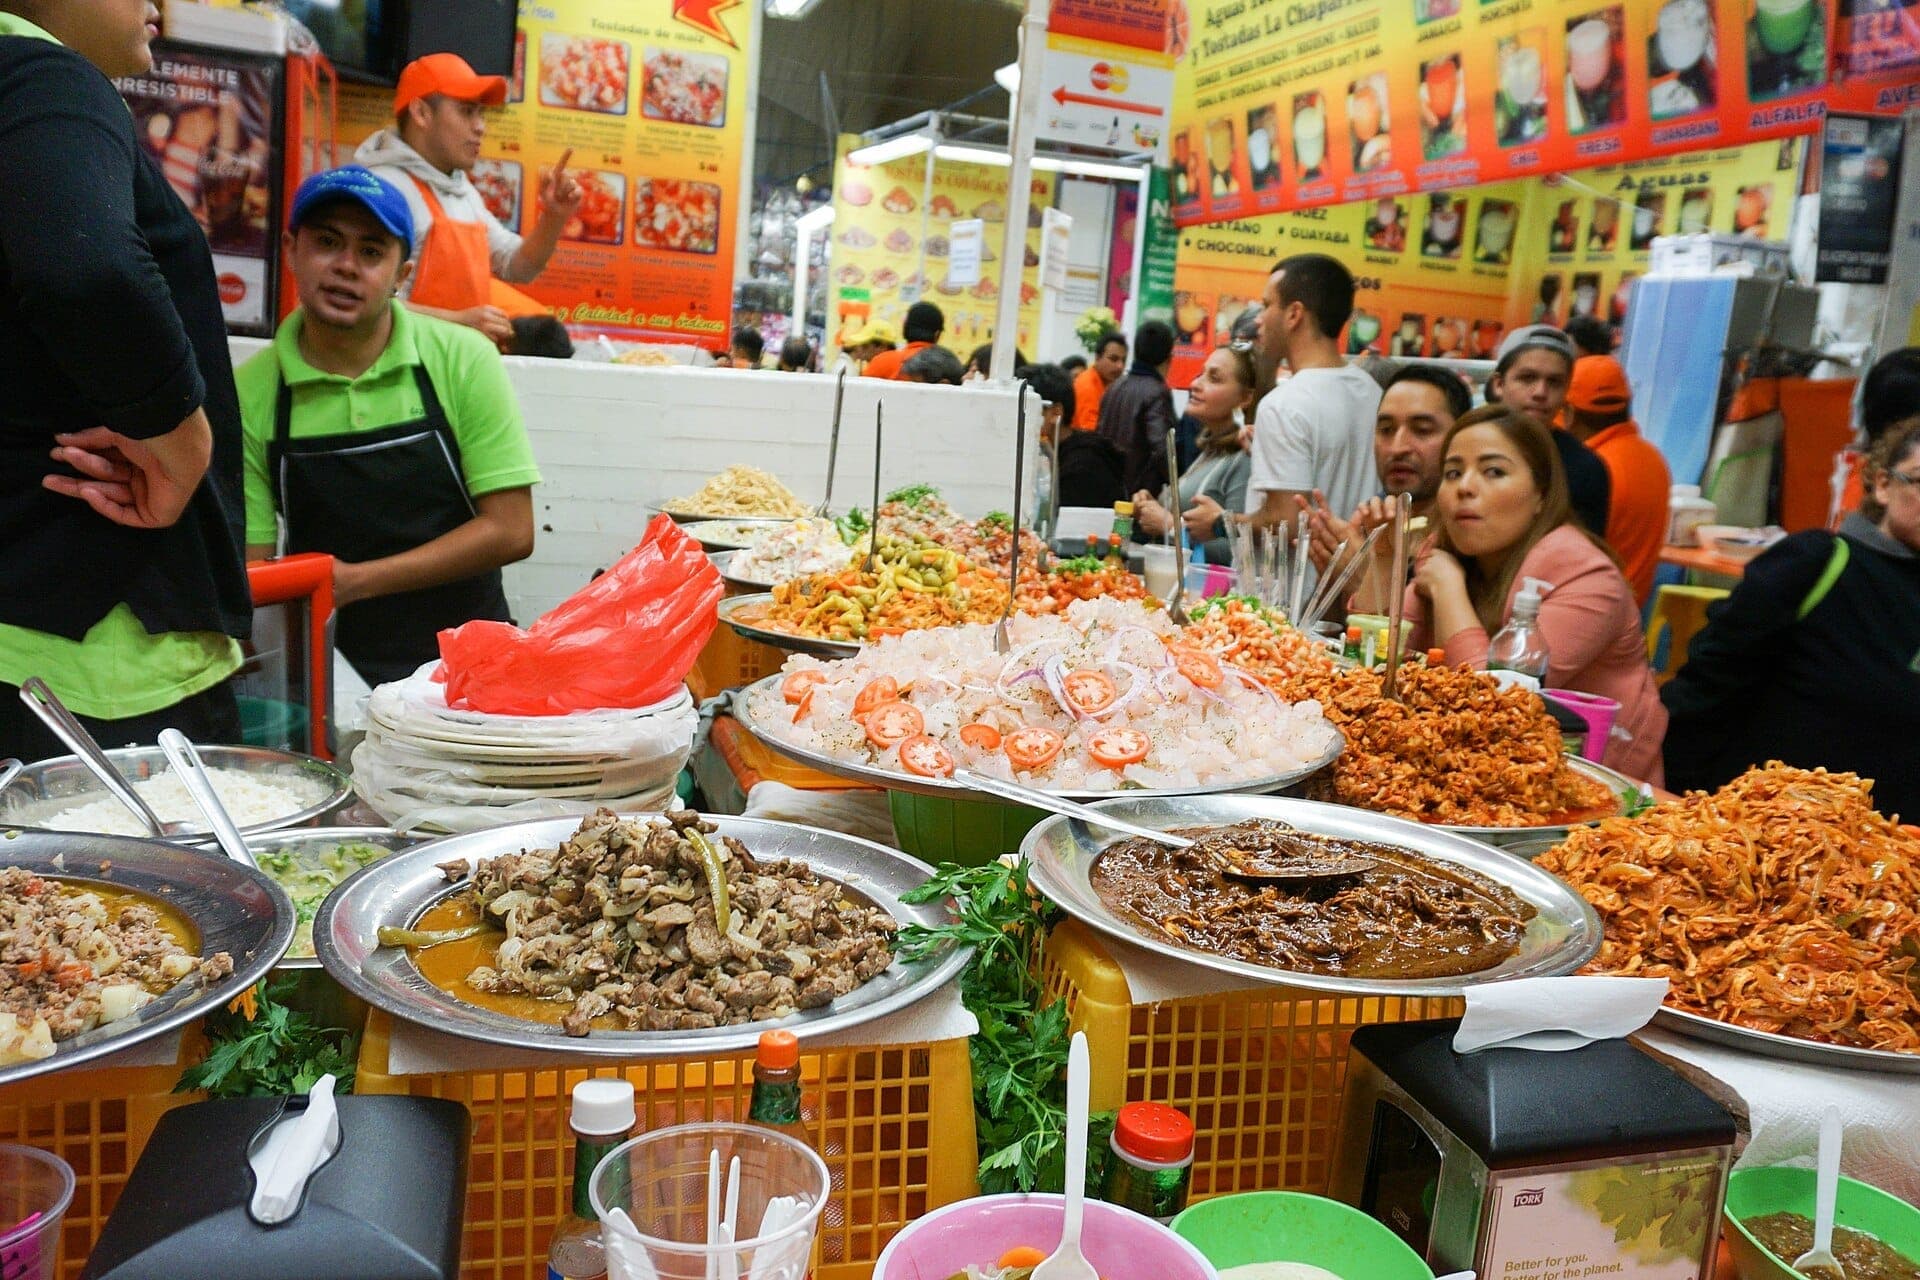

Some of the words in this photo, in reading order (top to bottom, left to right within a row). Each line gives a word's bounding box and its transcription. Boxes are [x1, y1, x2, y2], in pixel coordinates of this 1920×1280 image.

[1751, 101, 1827, 128] ALFALFA
[1614, 171, 1712, 196] Aguas
[1200, 220, 1262, 235] LATANO
[1289, 226, 1350, 244] GUAYABA
[1196, 238, 1279, 257] CHOCOMILK
[572, 303, 633, 325] Calidad
[1515, 1192, 1543, 1206] TORK
[1503, 1270, 1541, 1280] Better
[1544, 1268, 1562, 1280] for
[1563, 1266, 1581, 1278] the
[1583, 1262, 1624, 1278] planet.
[1504, 1259, 1541, 1273] Better
[1544, 1255, 1562, 1270] for
[1565, 1253, 1589, 1267] you.
